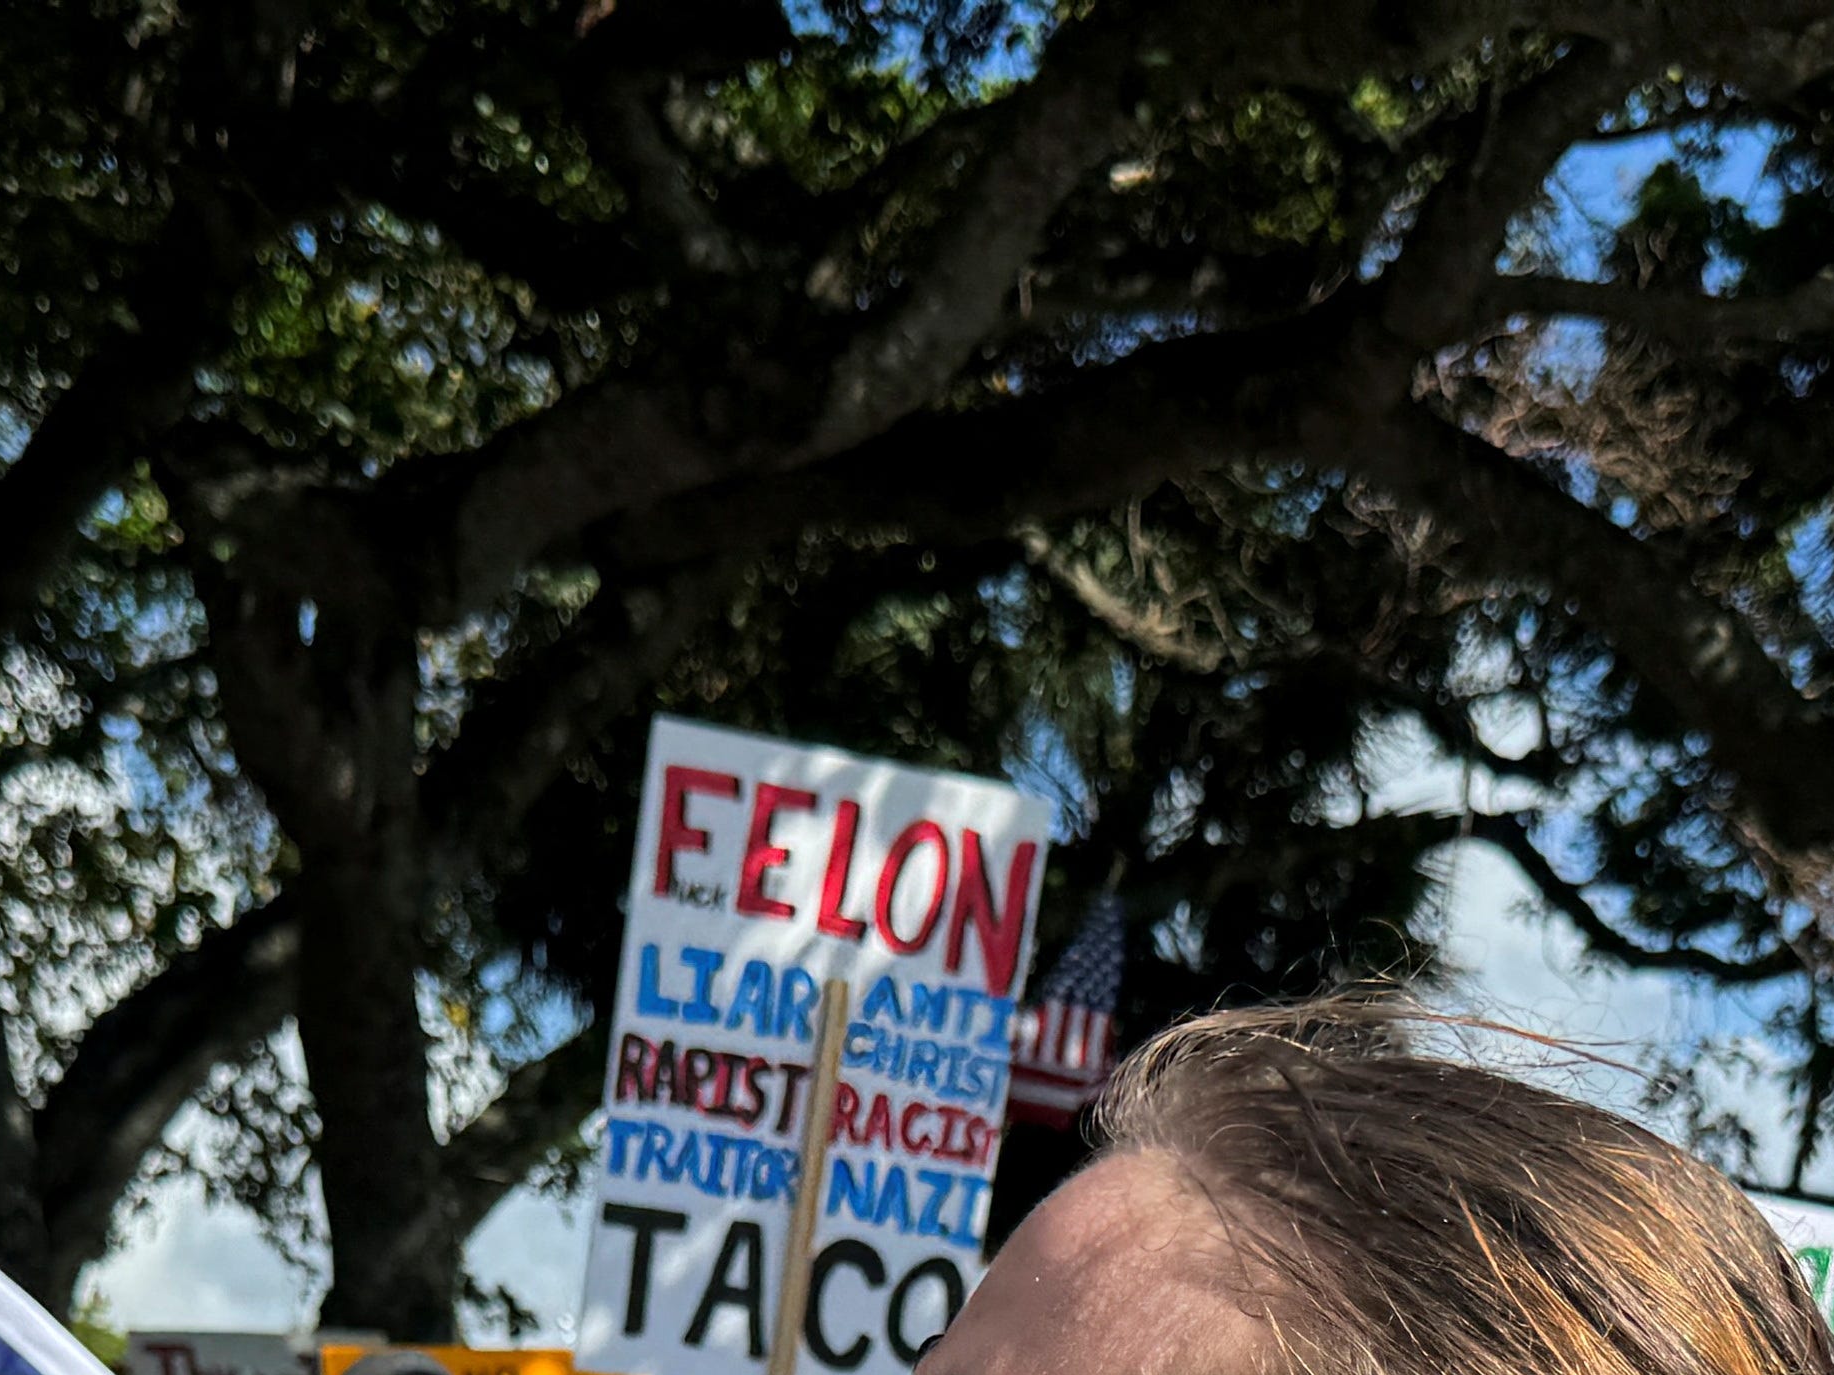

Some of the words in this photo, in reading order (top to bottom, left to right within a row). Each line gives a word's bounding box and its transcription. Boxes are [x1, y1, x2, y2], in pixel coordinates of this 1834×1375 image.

[653, 764, 1037, 1000] FELON
[635, 942, 819, 1043] LIAR
[863, 974, 1018, 1050] ANTI
[614, 1032, 813, 1137] RAPIST
[841, 1021, 1012, 1110] CHRIST
[606, 1115, 803, 1203] TRAITOR
[827, 1081, 999, 1168] RACIST
[825, 1159, 993, 1249] NAZI
[601, 1202, 966, 1372] TACO
